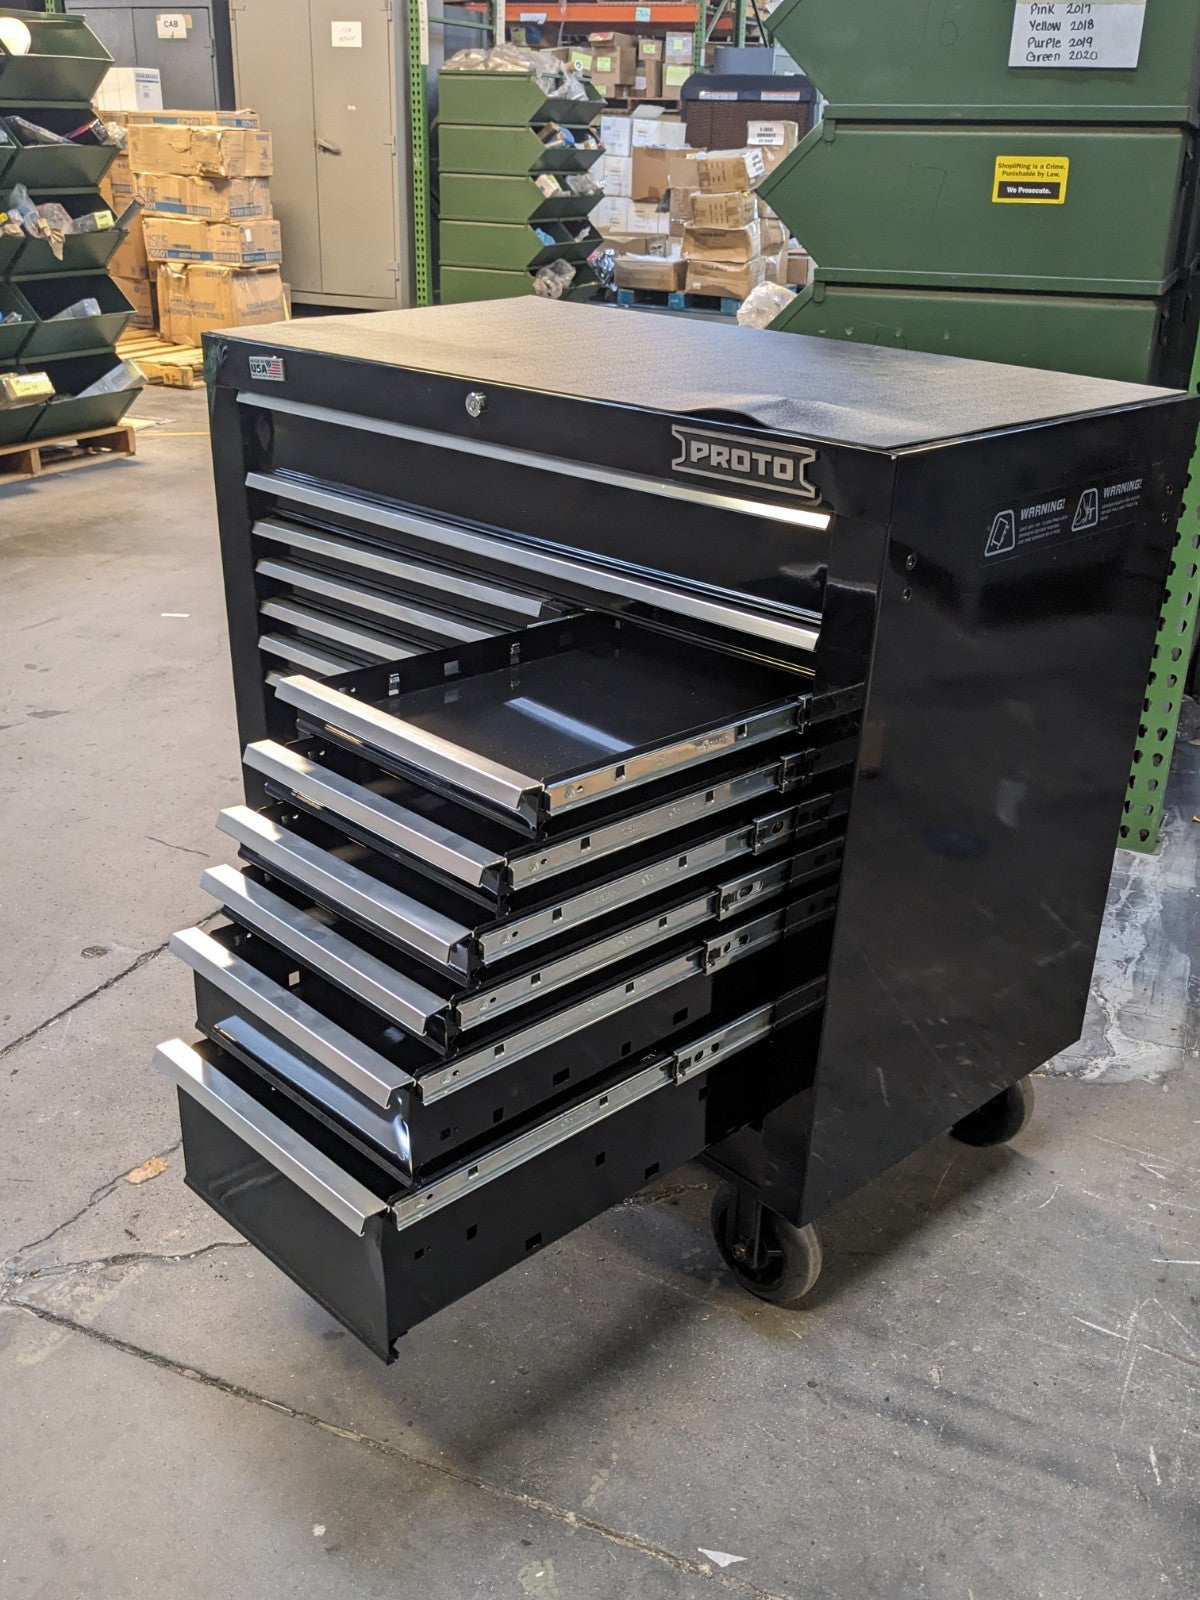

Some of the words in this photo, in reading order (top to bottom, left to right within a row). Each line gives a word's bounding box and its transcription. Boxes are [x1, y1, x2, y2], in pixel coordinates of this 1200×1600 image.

[1066, 3, 1091, 14] 2017
[163, 20, 179, 28] CAB
[1029, 20, 1061, 31] Yellow
[1070, 19, 1094, 31] 2018
[1068, 37, 1094, 48] 2019
[1026, 51, 1061, 62] Green
[1069, 51, 1098, 60] 2020
[1006, 186, 1017, 194] We
[1018, 186, 1052, 194] Prosecute.
[250, 364, 268, 374] USA
[690, 441, 794, 481] PROTO
[1104, 478, 1143, 499] WARNING!
[1020, 498, 1066, 521] WARNING!
